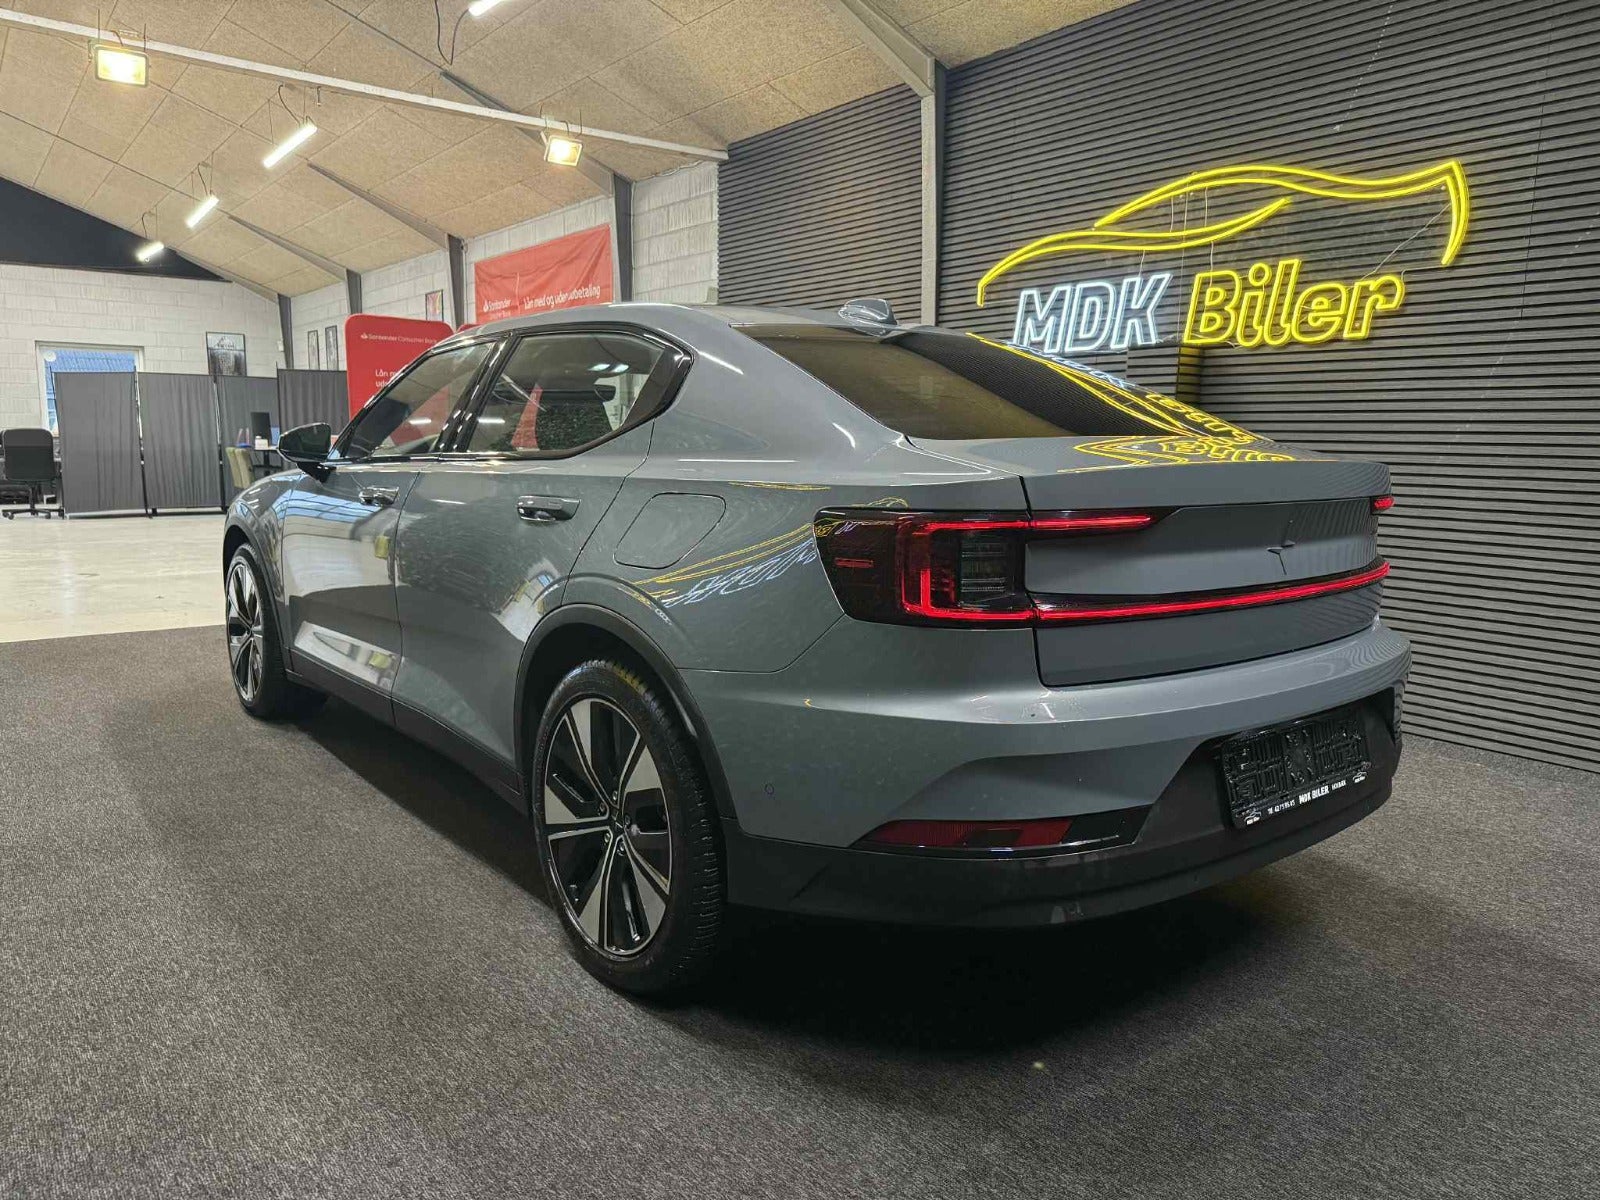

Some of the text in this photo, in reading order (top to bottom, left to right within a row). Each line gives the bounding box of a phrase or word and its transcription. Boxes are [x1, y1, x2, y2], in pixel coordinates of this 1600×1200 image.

[523, 297, 534, 310] Lån
[534, 294, 546, 307] med
[545, 294, 554, 309] og
[1012, 258, 1405, 354] MDK Biler
[368, 332, 397, 341] Santander
[375, 368, 389, 378] Lån
[1311, 785, 1330, 799] BILER
